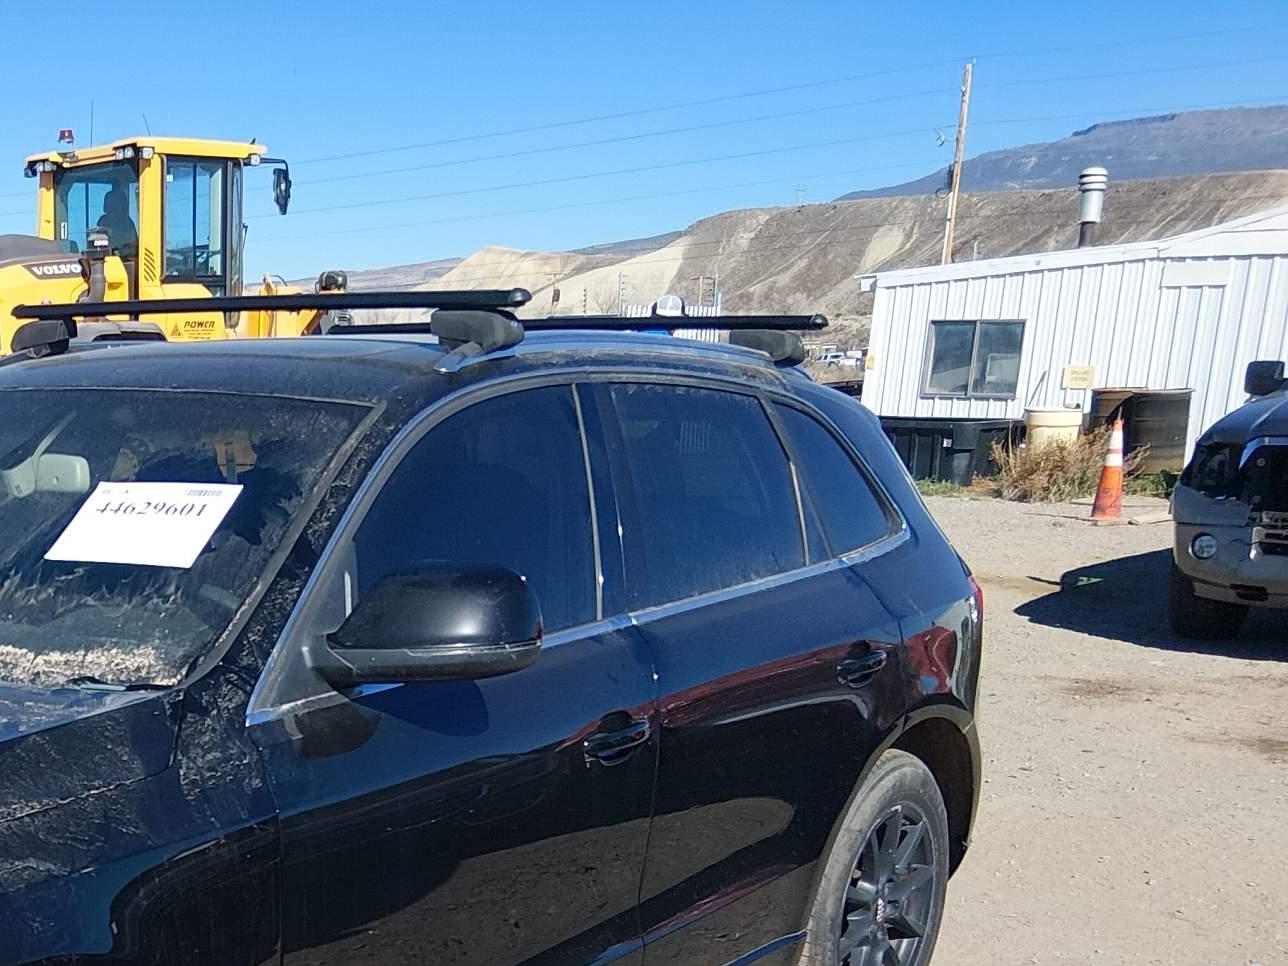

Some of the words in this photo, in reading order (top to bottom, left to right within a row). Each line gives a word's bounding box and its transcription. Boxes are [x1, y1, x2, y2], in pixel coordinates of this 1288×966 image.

[32, 263, 82, 275] VOLVO
[184, 320, 215, 329] POWER
[96, 501, 208, 517] 44629601
